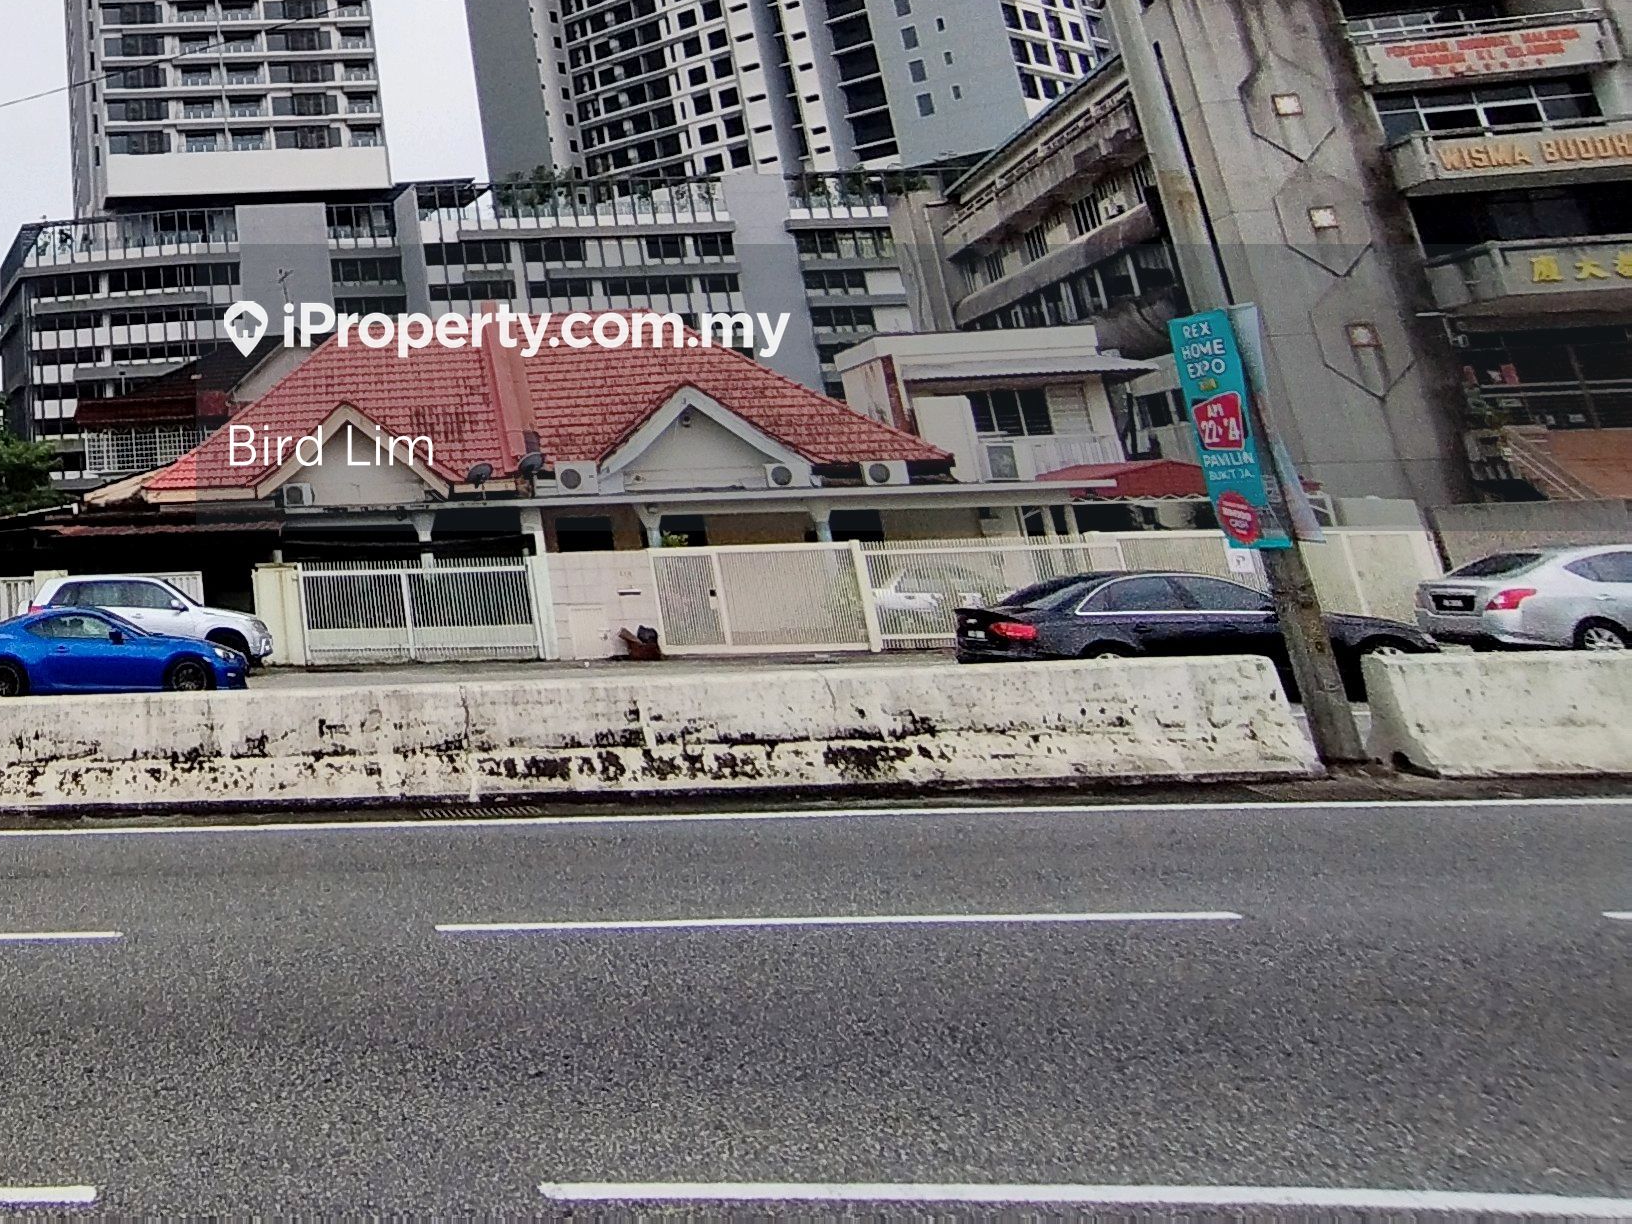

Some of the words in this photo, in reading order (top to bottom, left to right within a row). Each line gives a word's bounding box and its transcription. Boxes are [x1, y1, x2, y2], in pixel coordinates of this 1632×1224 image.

[1438, 144, 1533, 171] WISMA
[1182, 321, 1211, 339] REX
[1180, 338, 1226, 360] HOME
[1186, 358, 1226, 378] EXPO
